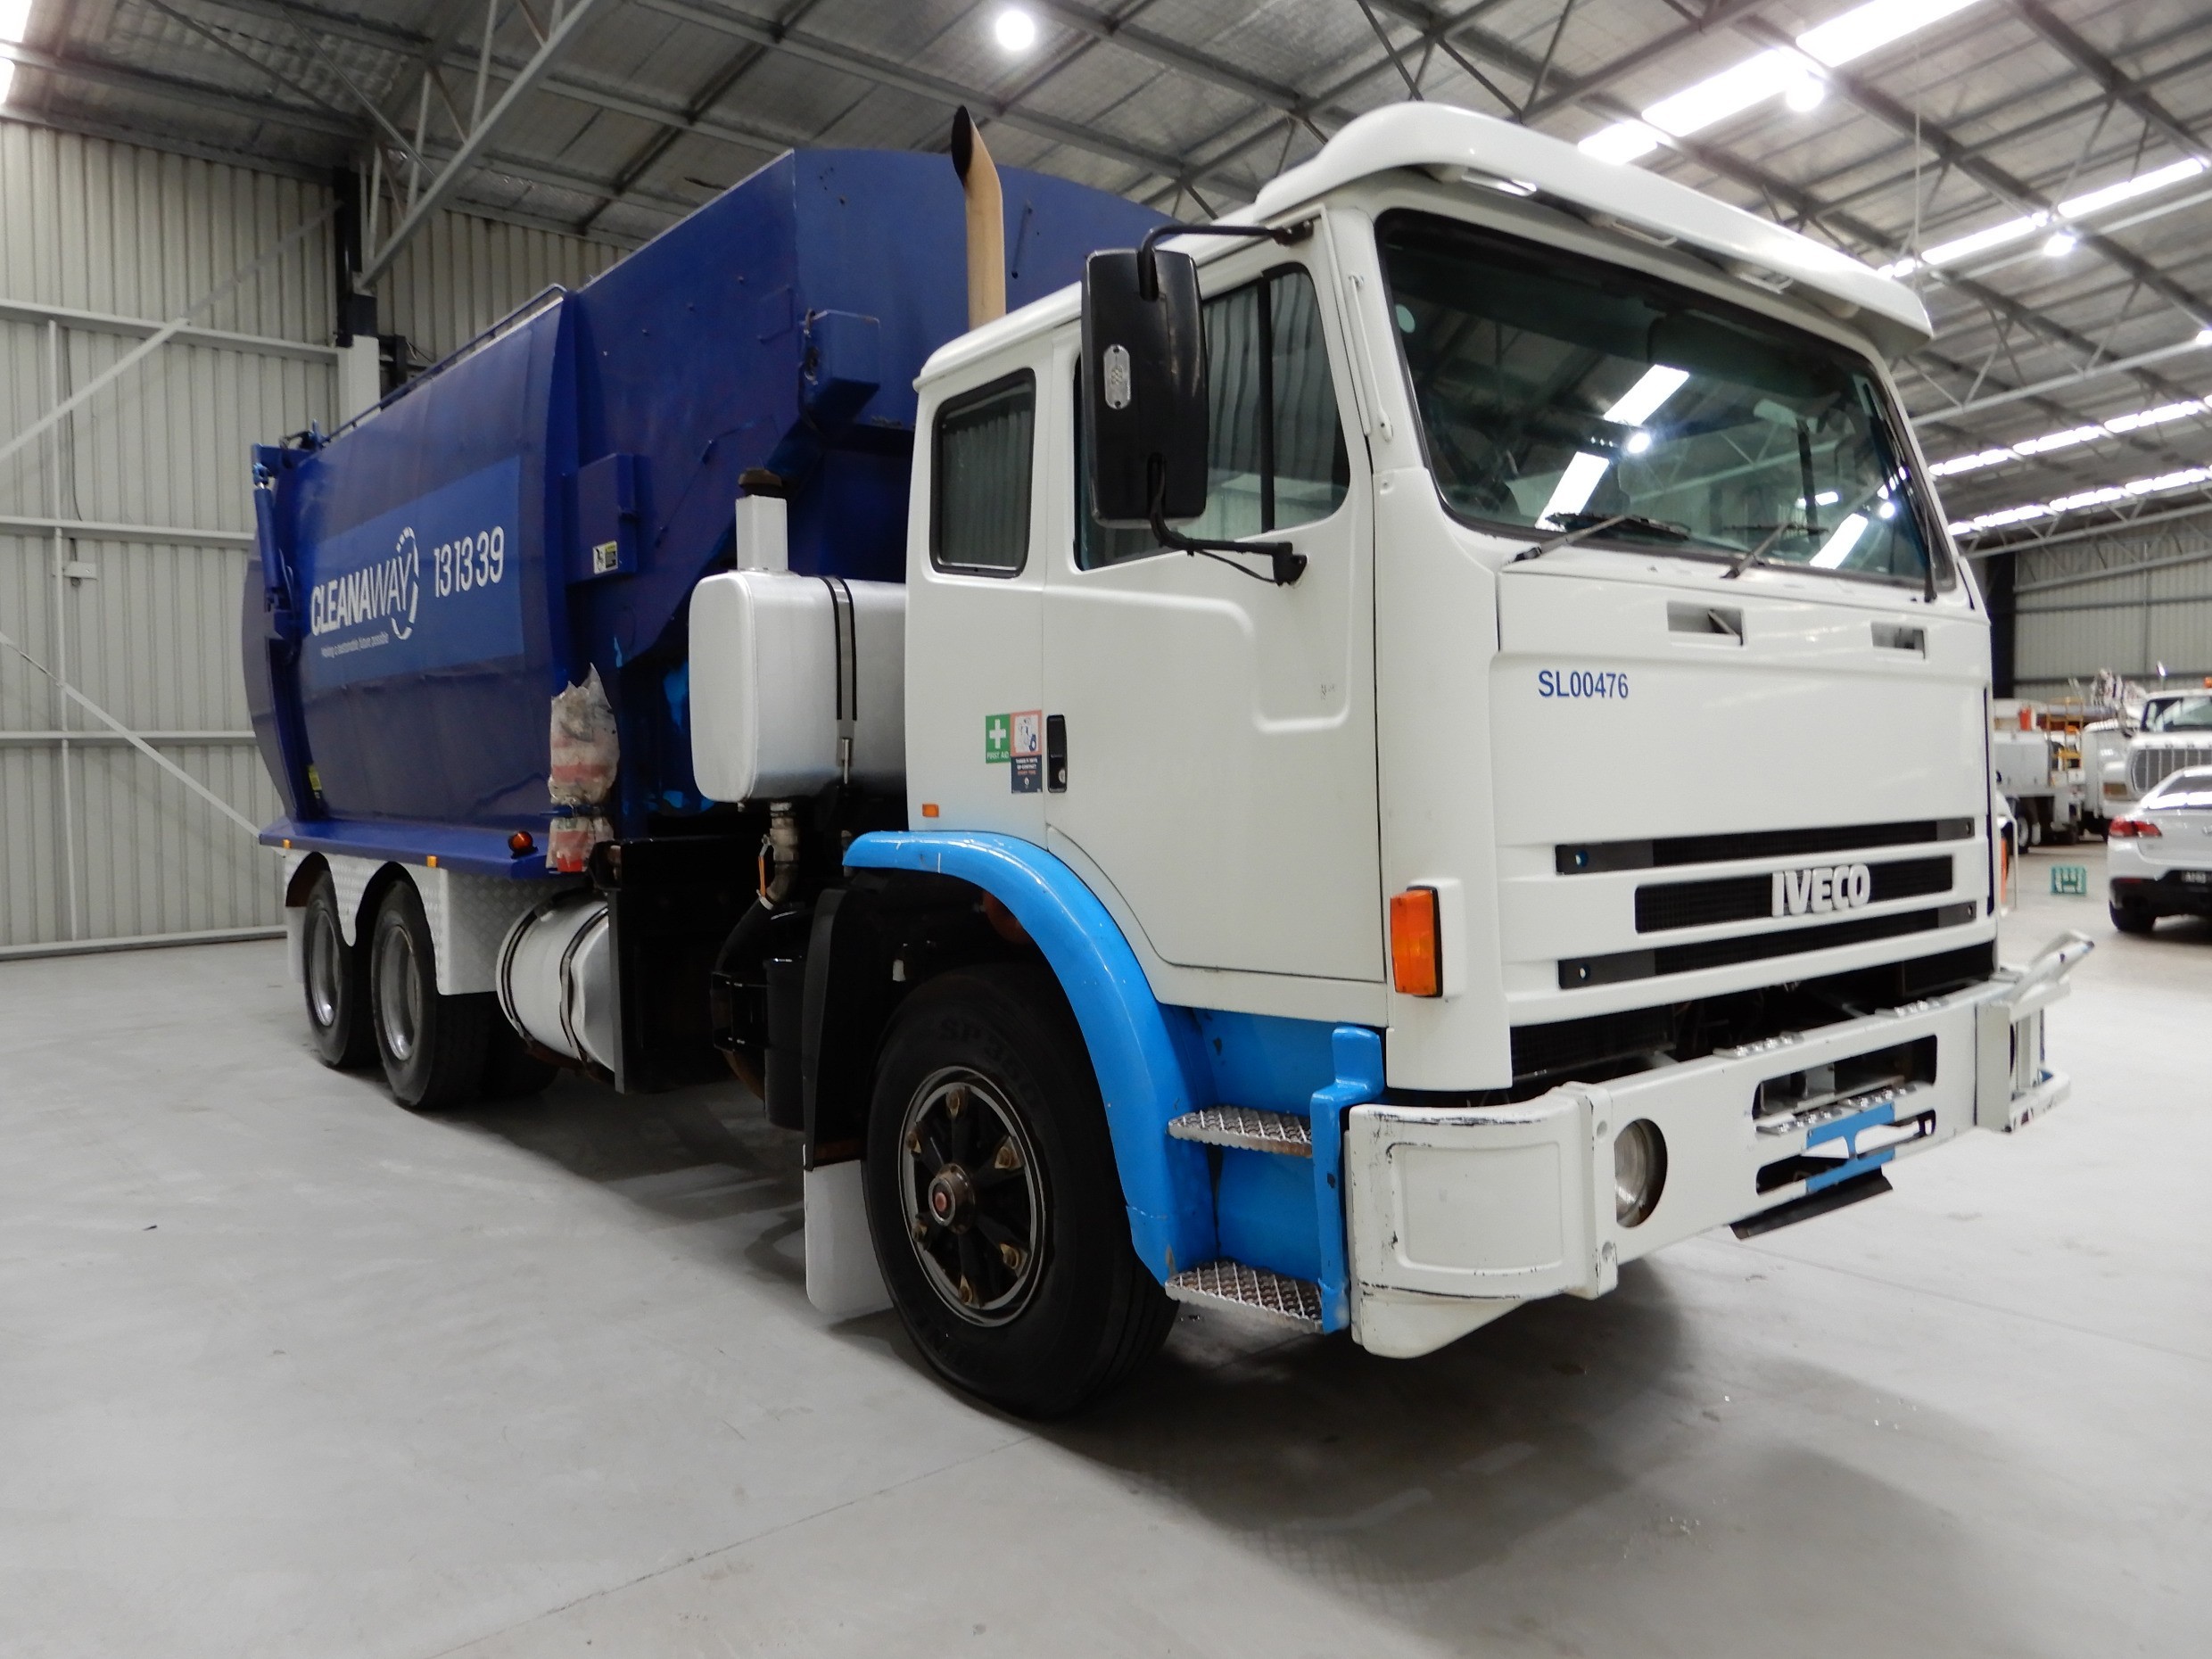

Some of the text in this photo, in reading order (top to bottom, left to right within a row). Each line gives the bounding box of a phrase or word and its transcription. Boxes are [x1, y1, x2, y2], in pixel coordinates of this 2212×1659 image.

[311, 553, 413, 636] CLEANAWAY
[1538, 670, 1630, 700] SL00476
[986, 751, 1010, 760] FIRST AID
[1771, 863, 1871, 918] IVECO
